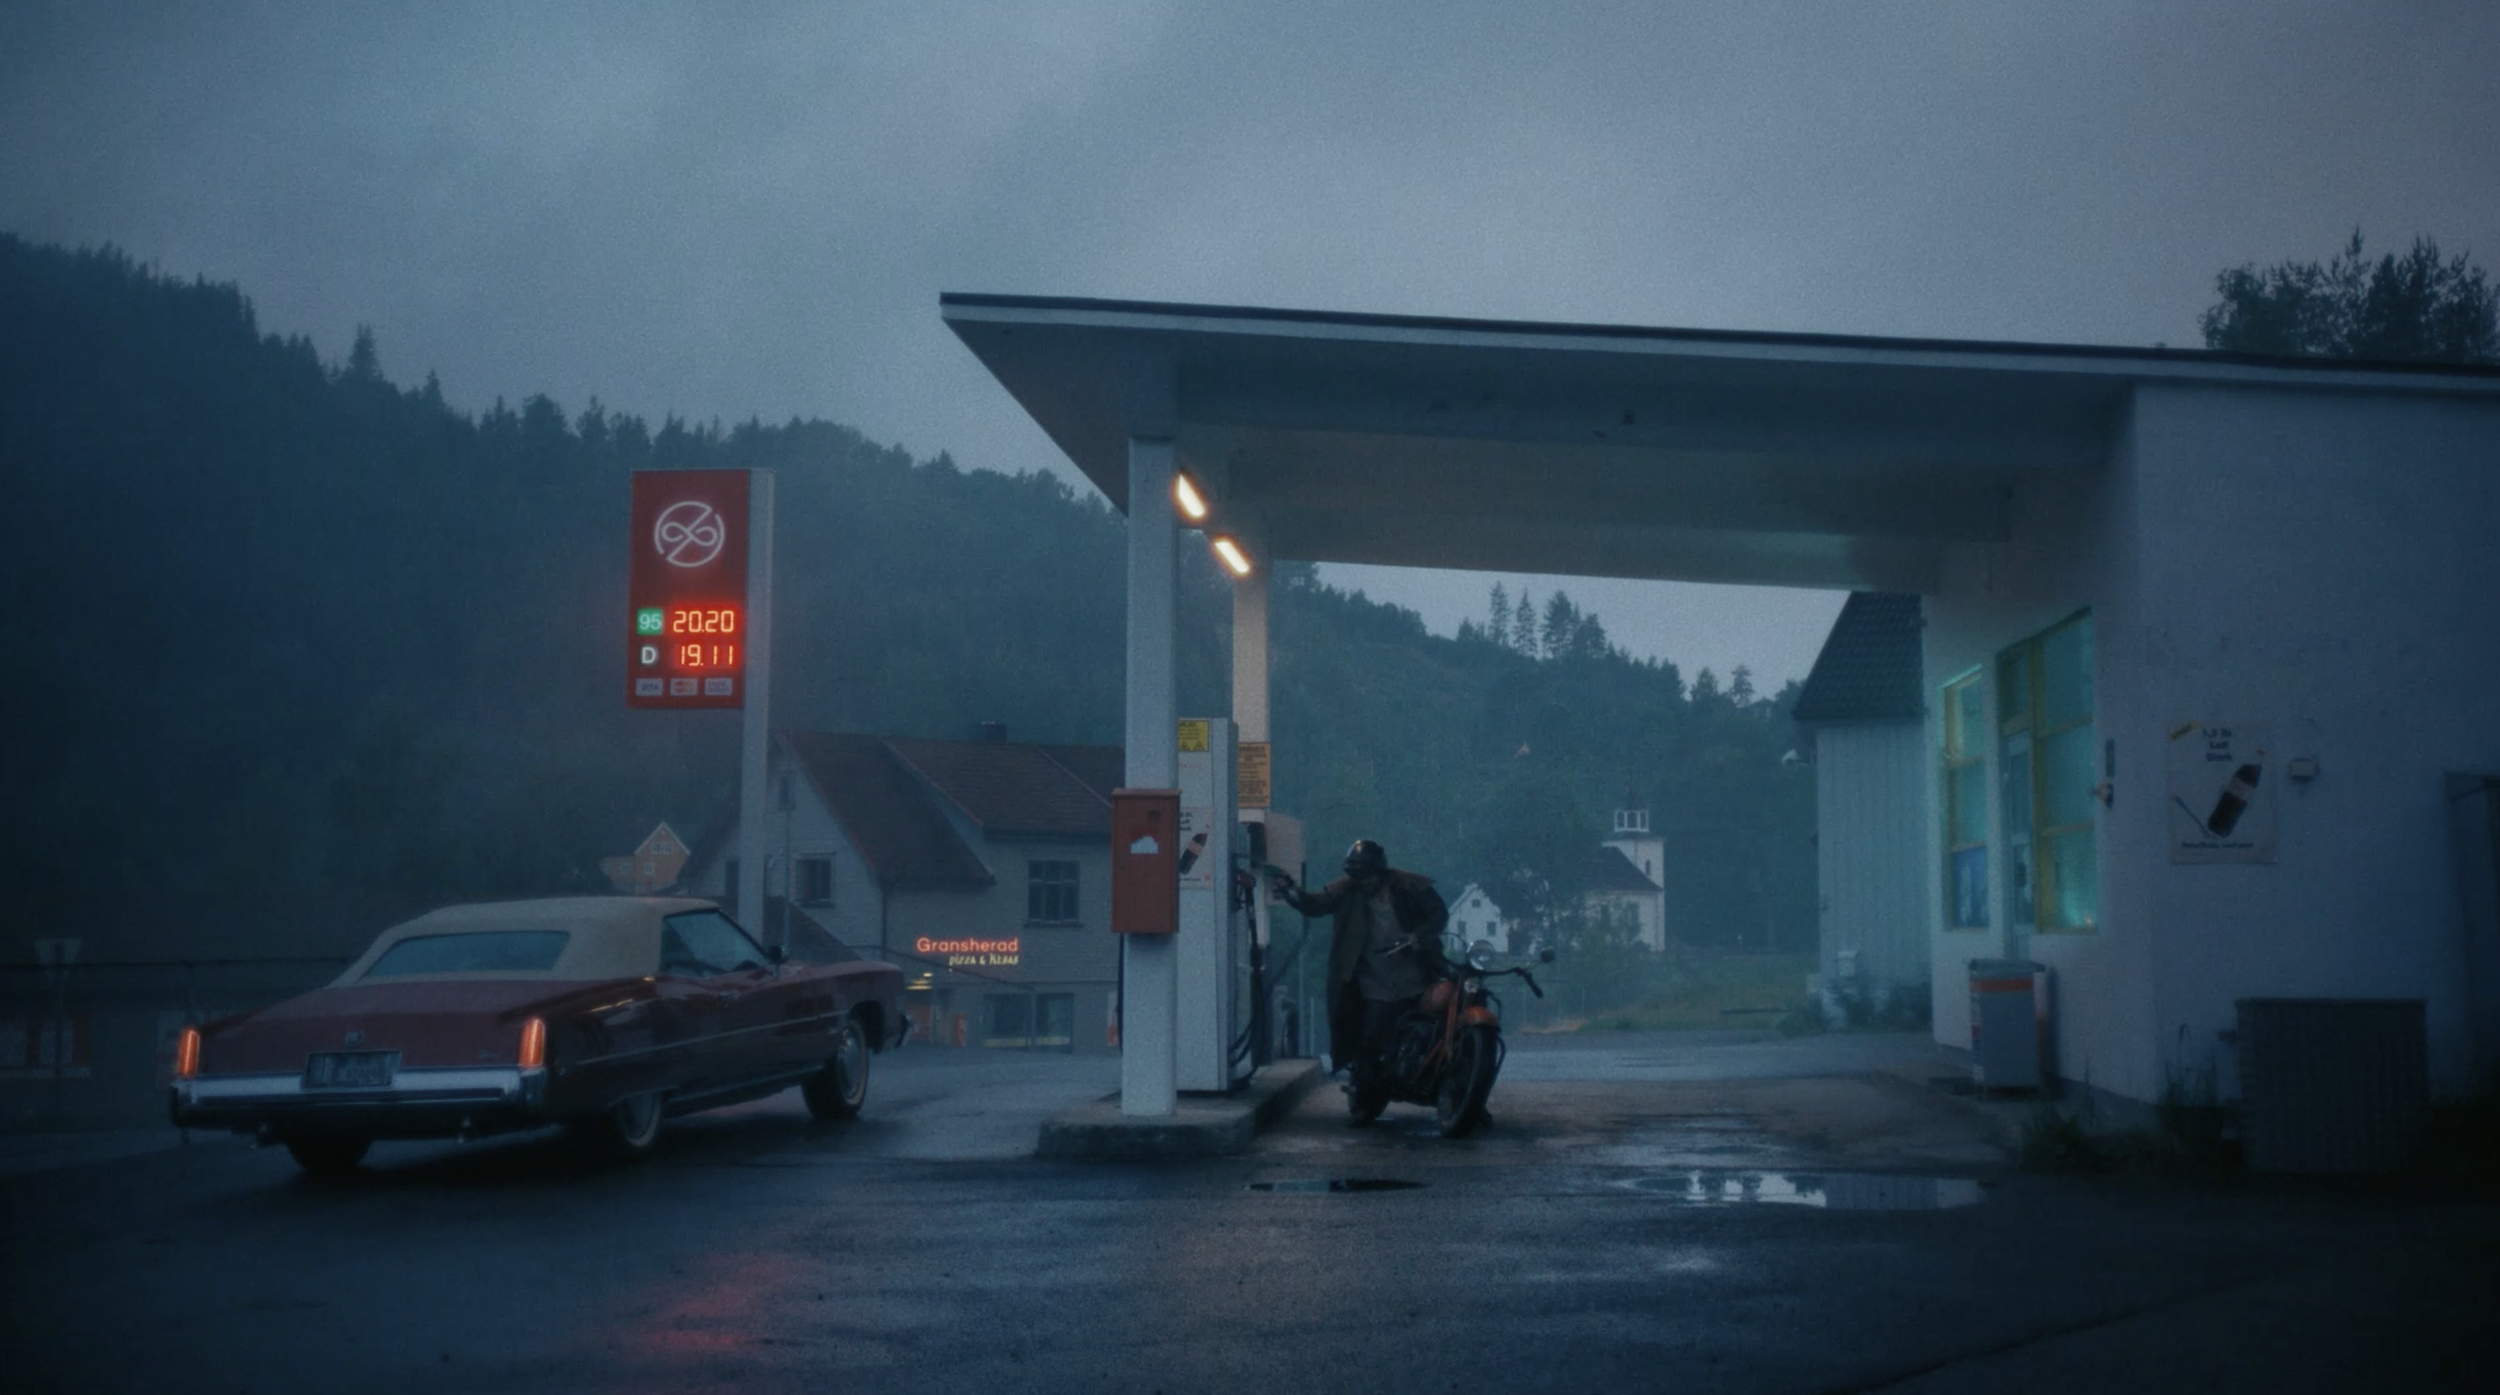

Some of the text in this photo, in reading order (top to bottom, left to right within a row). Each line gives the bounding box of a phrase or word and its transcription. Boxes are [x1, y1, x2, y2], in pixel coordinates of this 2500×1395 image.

[638, 610, 735, 633] 95 20.20
[640, 643, 734, 666] D 19.11
[916, 937, 1019, 952] Gransherad
